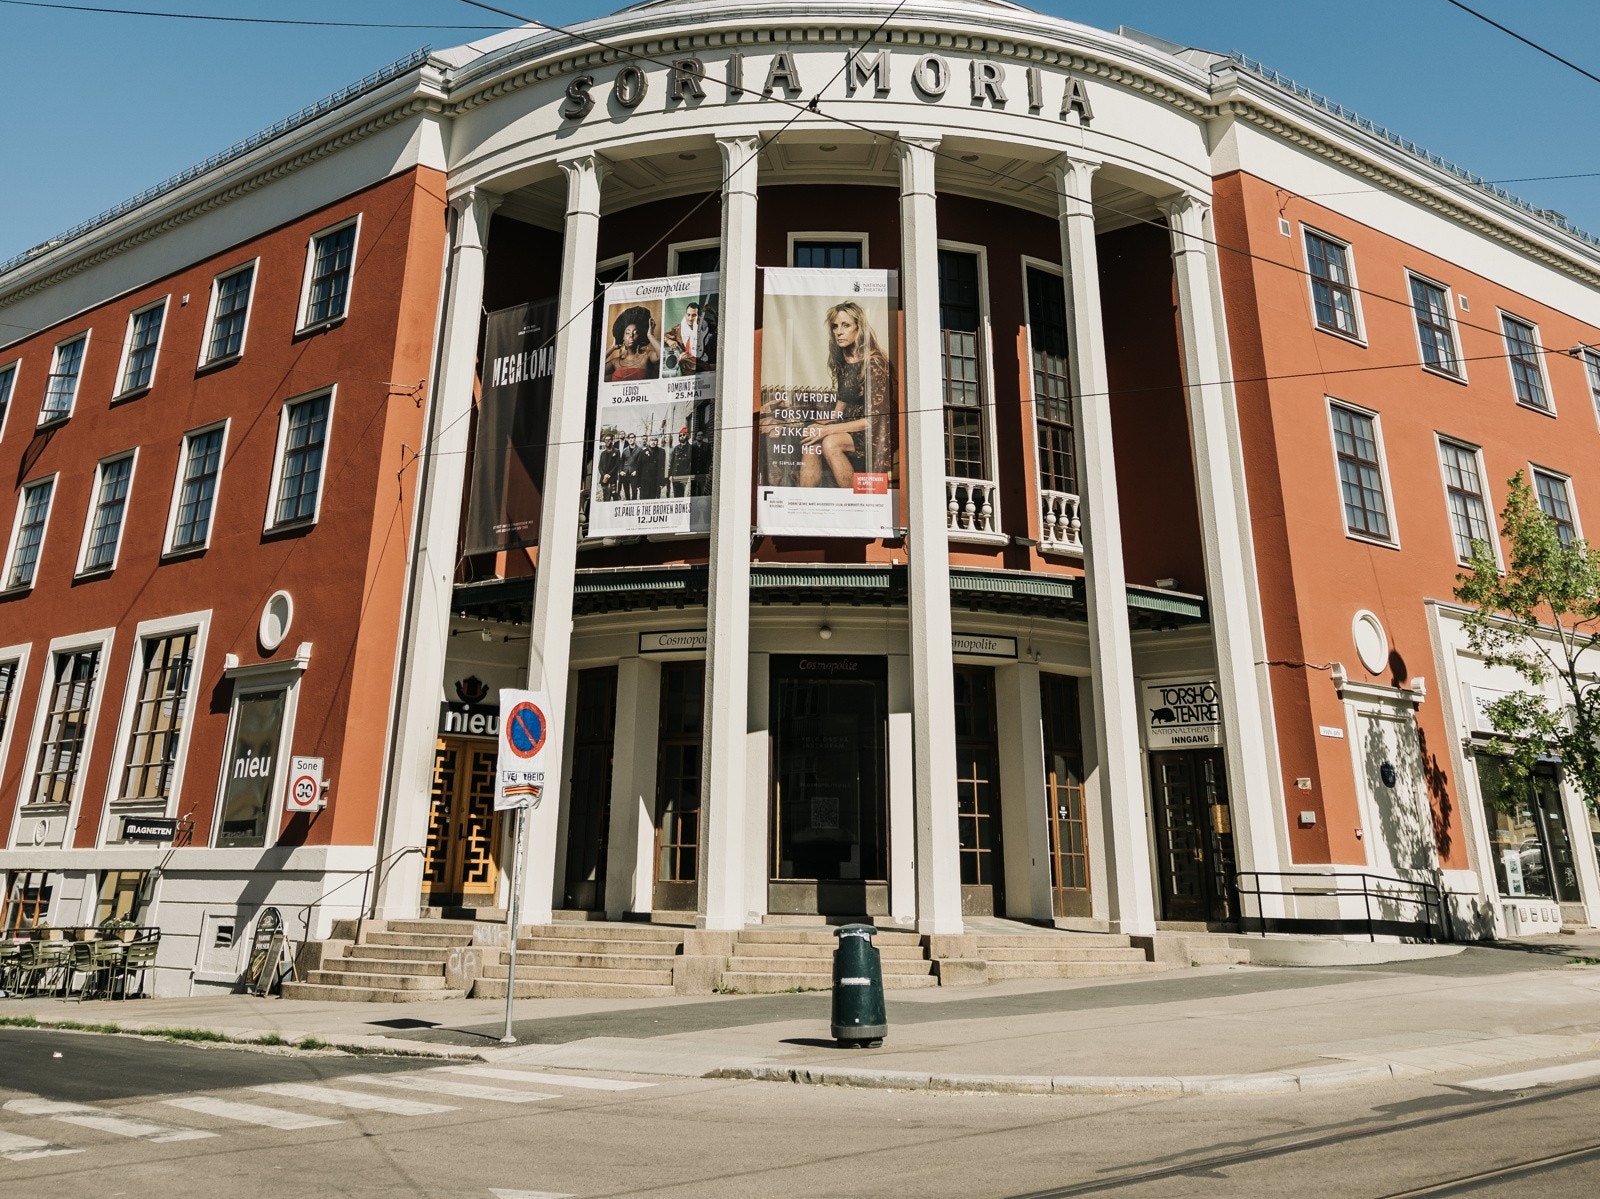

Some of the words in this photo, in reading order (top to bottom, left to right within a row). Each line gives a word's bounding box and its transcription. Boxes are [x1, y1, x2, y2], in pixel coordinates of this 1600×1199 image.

[564, 50, 803, 120] SORIA
[847, 47, 1095, 121] MORIA
[635, 280, 691, 296] Cosmopolite
[612, 394, 649, 404] 30.APRIL
[774, 391, 788, 401] OG
[795, 392, 837, 403] VERDEN
[774, 408, 844, 421] FORSVINNER
[774, 426, 823, 437] SIKKERT
[773, 444, 795, 454] MED
[801, 445, 823, 455] MEG
[642, 505, 652, 515] THE
[653, 504, 674, 515] BROKEN
[637, 515, 668, 524] 12.JUNI
[799, 658, 858, 675] Cosmopolite
[444, 704, 500, 735] nieu
[1171, 735, 1209, 744] INNGANG
[233, 749, 271, 779] nieu
[297, 760, 318, 771] Sone
[297, 783, 313, 798] 30
[127, 825, 172, 836] MAGNETEN
